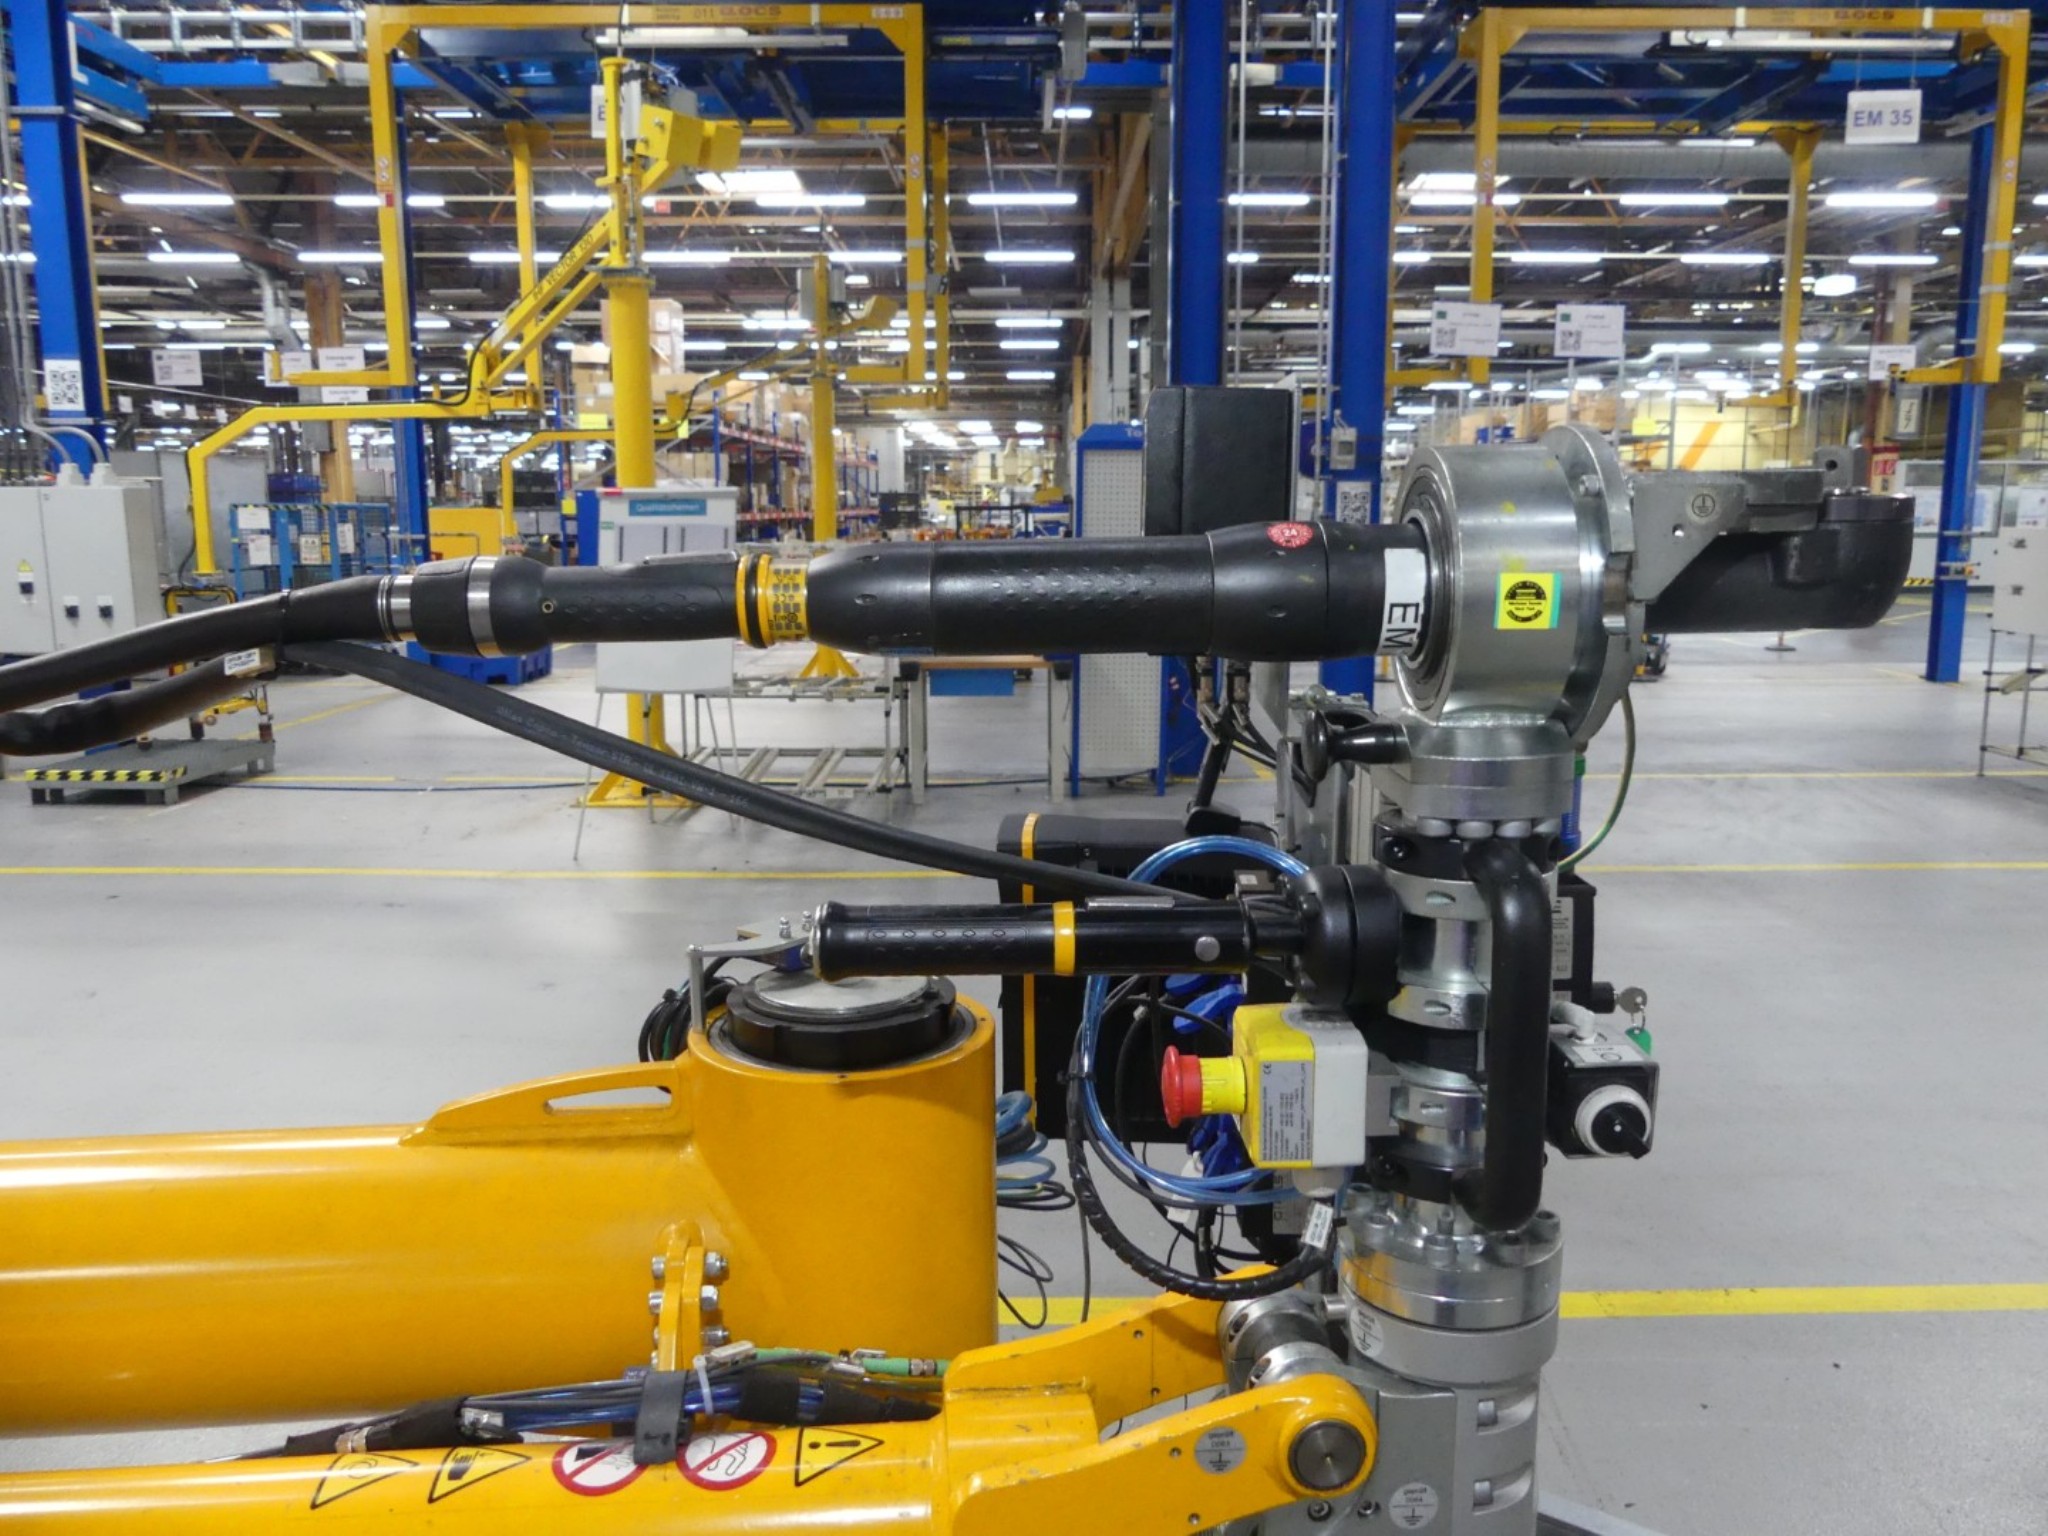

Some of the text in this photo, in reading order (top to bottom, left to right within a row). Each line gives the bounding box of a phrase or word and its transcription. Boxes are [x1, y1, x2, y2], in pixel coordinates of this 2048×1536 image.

[1853, 109, 1914, 128] EM 35
[1382, 603, 1420, 648] EM
